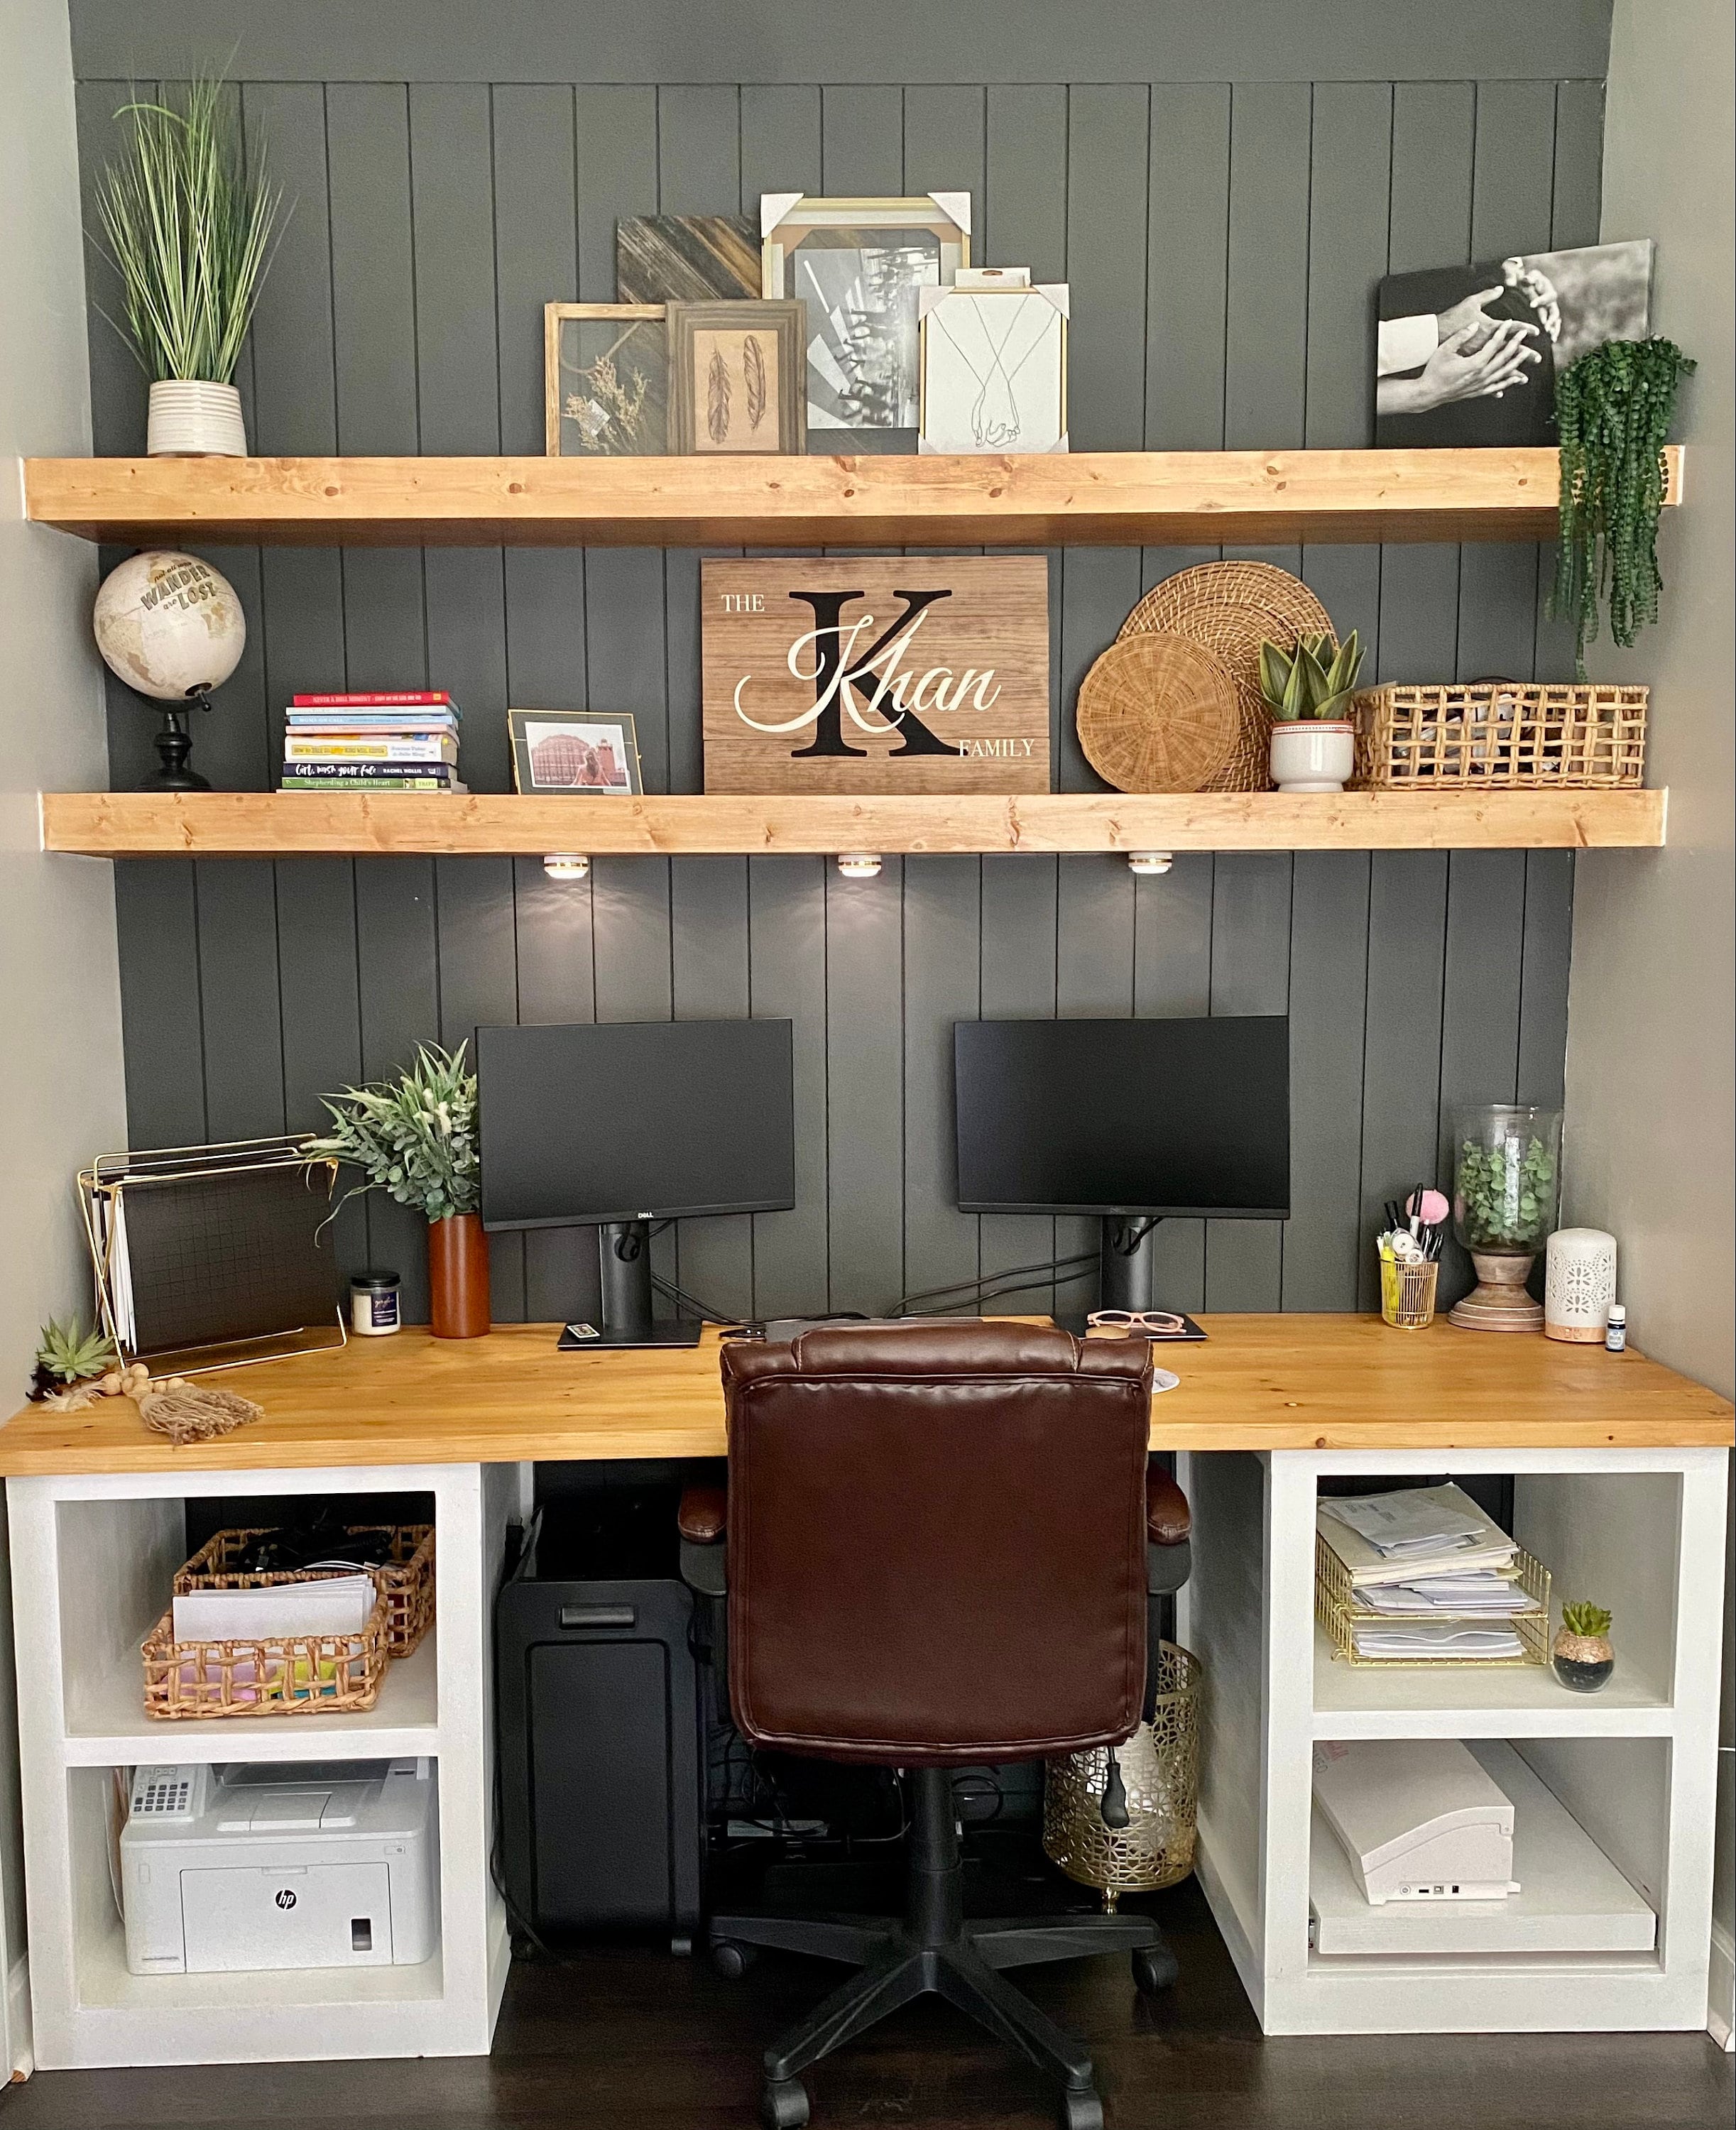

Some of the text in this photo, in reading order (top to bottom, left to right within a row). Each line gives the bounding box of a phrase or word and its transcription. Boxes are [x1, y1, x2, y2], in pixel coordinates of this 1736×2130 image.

[141, 565, 210, 610] WANDER
[178, 581, 216, 610] LOST
[721, 594, 765, 612] THE
[733, 608, 1002, 734] Khan
[789, 590, 968, 757] K
[959, 738, 1034, 758] FAMILY
[277, 1889, 295, 1911] hp
